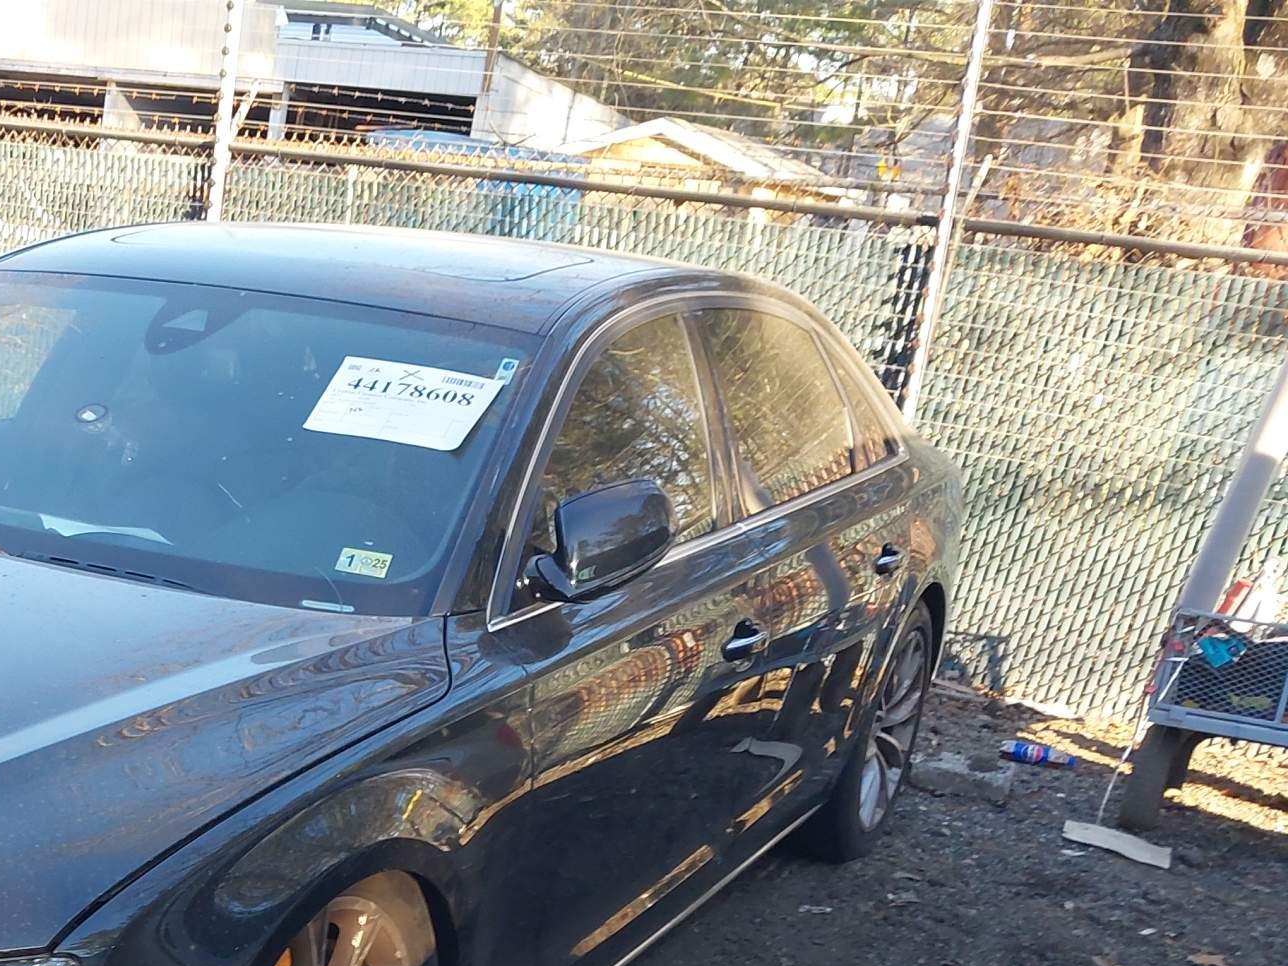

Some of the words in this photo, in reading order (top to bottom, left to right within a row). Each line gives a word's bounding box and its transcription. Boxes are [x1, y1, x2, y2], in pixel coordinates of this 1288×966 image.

[347, 377, 476, 407] 44178608
[346, 553, 357, 568] 1
[371, 558, 389, 570] 25
